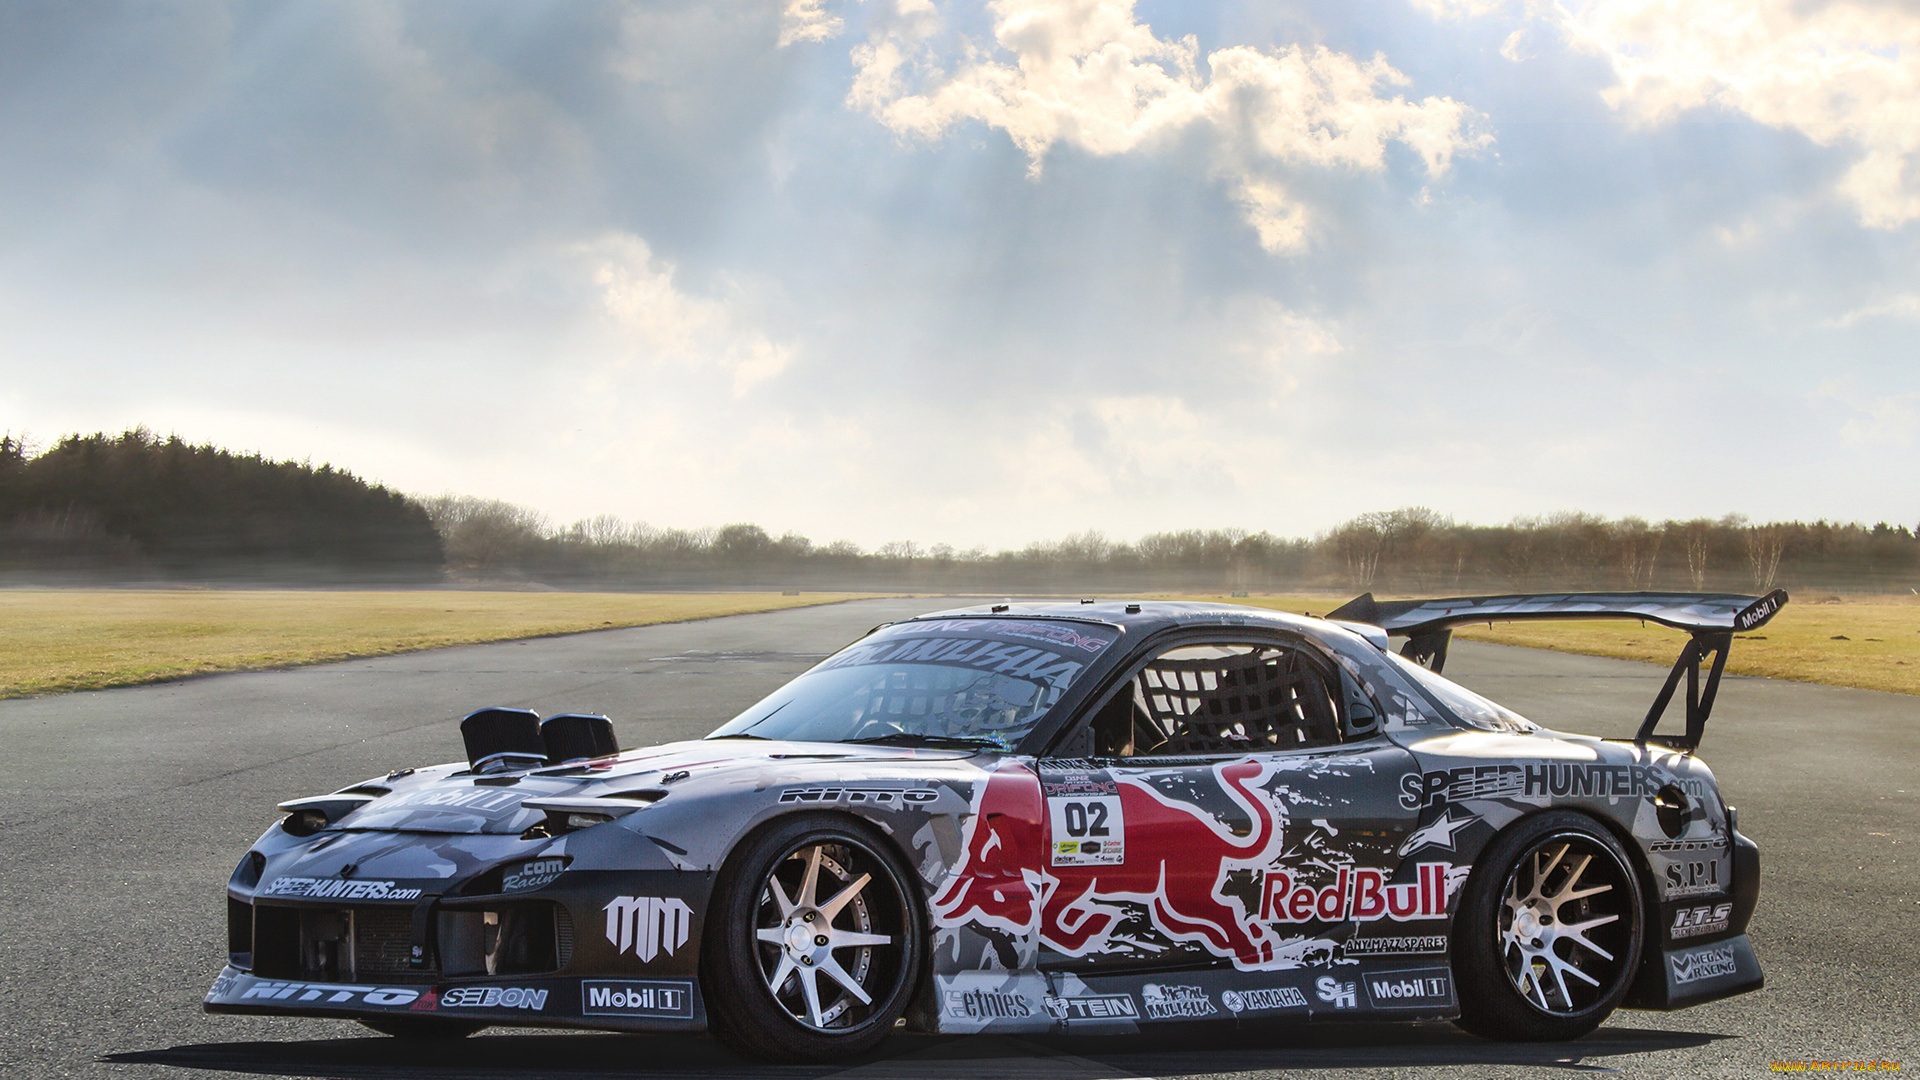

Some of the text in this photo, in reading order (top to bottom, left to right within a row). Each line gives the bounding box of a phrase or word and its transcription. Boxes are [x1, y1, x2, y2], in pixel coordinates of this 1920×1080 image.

[1742, 601, 1771, 628] Mobil
[778, 787, 939, 803] NITTO
[1042, 780, 1119, 796] DRIFTING
[1399, 763, 1704, 811] SPEEDHUNTERSom
[1064, 802, 1109, 837] 02
[1649, 838, 1729, 852] NITTO
[519, 860, 563, 876] .com
[264, 877, 422, 899] SPEEDHUNTERS.com
[1259, 865, 1446, 921] Red Bull
[1345, 939, 1369, 951] ANY
[1372, 938, 1402, 949] MAZZ
[1405, 936, 1447, 948] SPARES
[1691, 949, 1734, 964] MEGAN
[1693, 961, 1736, 979] RACING
[240, 981, 419, 1005] NITTO
[441, 987, 548, 1010] SEIBON
[590, 987, 654, 1008] Mobil
[1160, 985, 1209, 1001] METAL
[1239, 987, 1307, 1010] YAMAHA
[1373, 978, 1425, 999] Mobil
[963, 988, 1030, 1018] etnies
[1069, 998, 1135, 1017] TEIN
[1145, 1000, 1217, 1019] MULISHA
